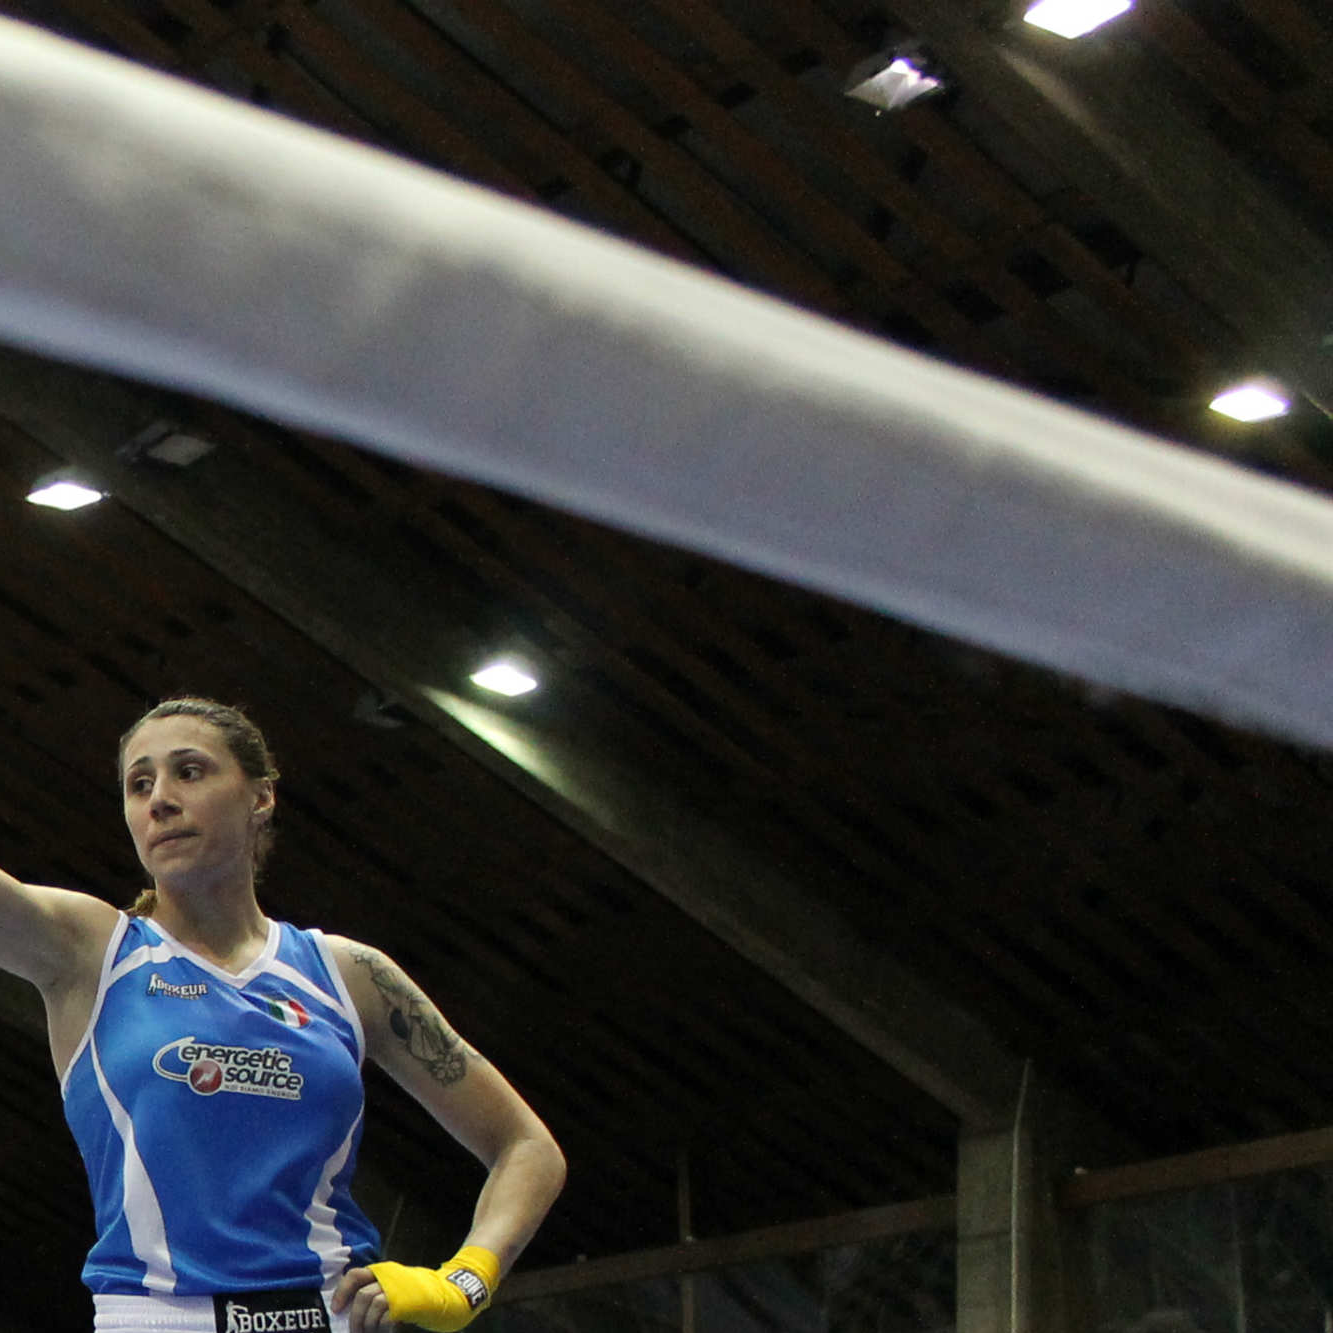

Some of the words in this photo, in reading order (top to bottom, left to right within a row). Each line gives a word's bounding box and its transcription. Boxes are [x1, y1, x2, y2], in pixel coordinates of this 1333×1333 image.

[181, 1045, 290, 1071] energetic
[224, 1066, 302, 1090] source
[447, 1269, 487, 1306] LEONE
[237, 1308, 326, 1333] BOXEUR
